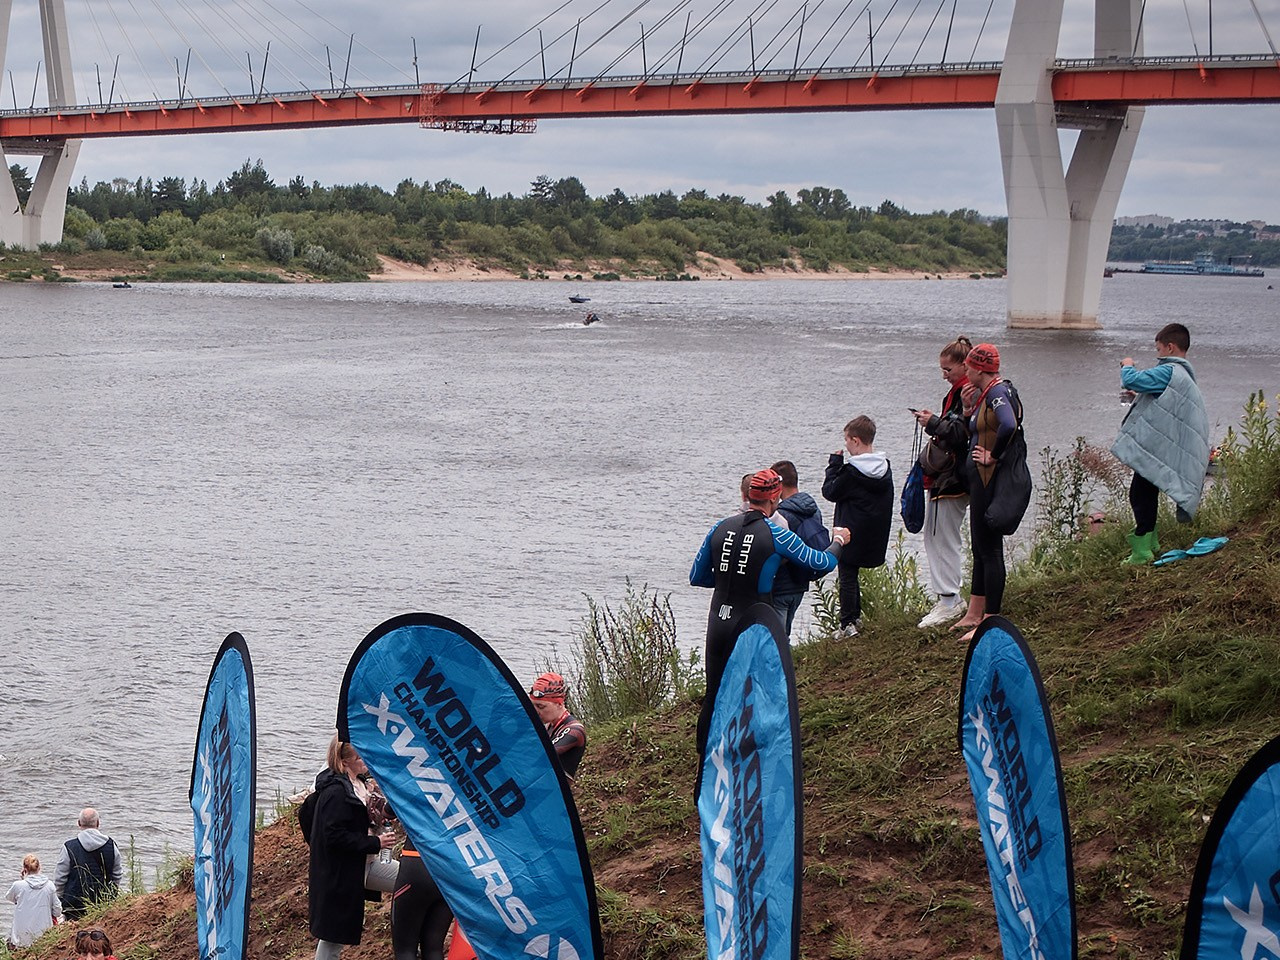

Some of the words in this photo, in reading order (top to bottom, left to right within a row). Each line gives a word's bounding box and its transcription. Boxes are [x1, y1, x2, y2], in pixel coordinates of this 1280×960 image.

[720, 530, 736, 573] HUUB
[737, 533, 754, 575] HUUB
[393, 681, 500, 830] CHAMPIONSHIP
[412, 656, 526, 818] WORLD
[991, 669, 1042, 861] WORLD
